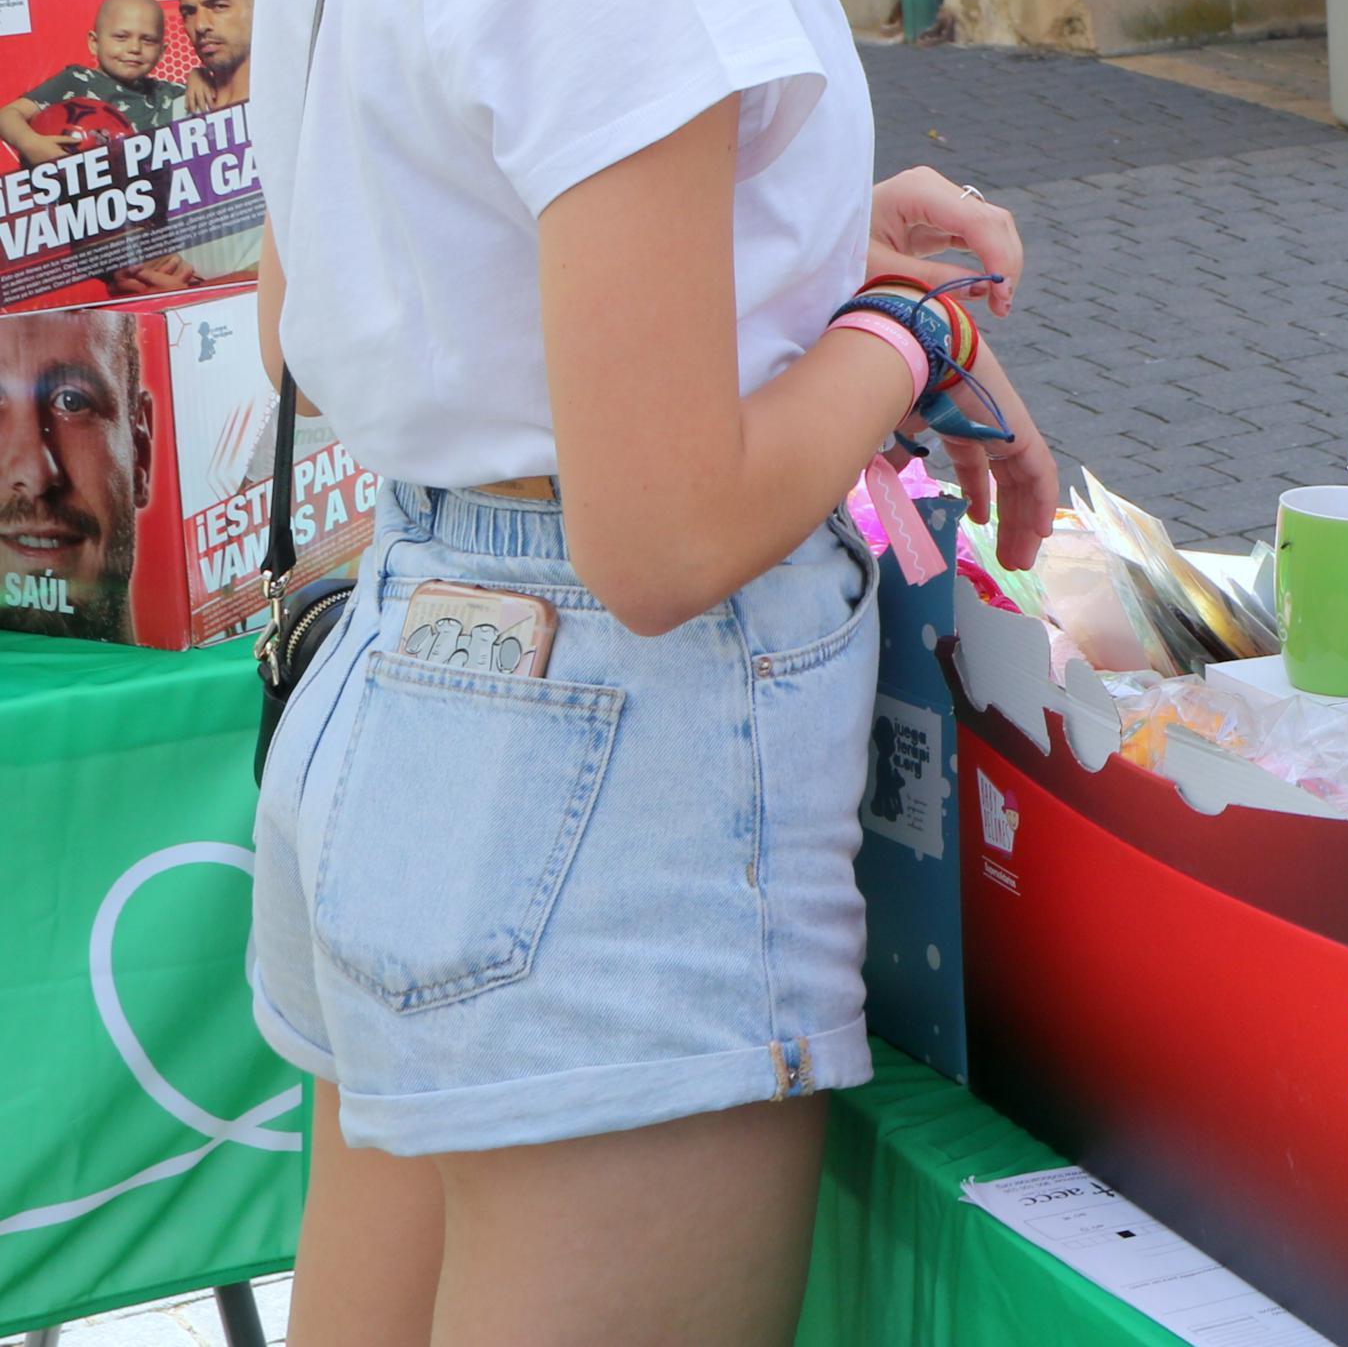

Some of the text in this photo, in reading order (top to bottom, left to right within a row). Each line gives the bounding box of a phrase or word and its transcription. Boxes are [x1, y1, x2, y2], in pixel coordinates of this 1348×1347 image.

[123, 103, 254, 179] PARTI
[0, 144, 263, 261] VAMOS A GA
[295, 441, 364, 503] PAR
[199, 471, 384, 594] VAMS A G
[5, 569, 74, 615] SAÚL
[894, 717, 926, 748] juega
[980, 776, 1002, 805] BABY
[1018, 1186, 1085, 1207] aecc
